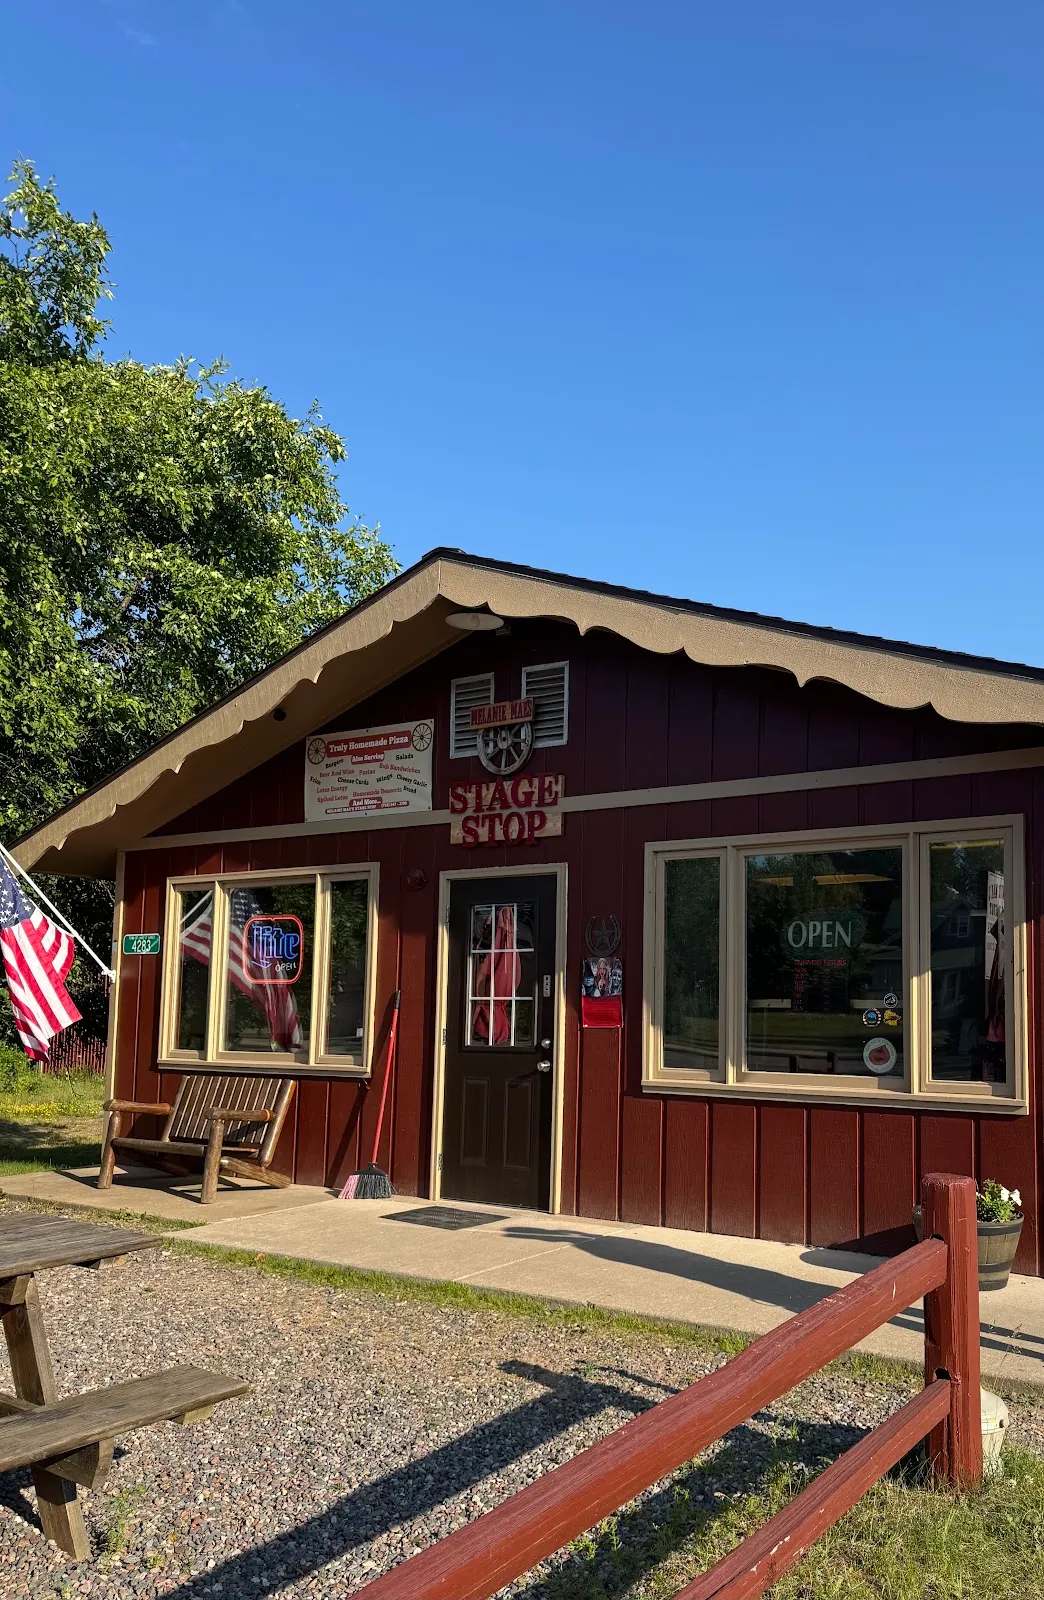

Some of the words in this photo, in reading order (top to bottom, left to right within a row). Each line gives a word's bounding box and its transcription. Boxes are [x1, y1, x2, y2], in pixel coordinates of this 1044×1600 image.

[329, 742, 348, 753] Truly
[348, 738, 388, 750] Homemade
[388, 735, 409, 745] Pizza
[364, 752, 385, 761] Serving
[395, 752, 414, 760] Salads
[325, 758, 344, 769] Burgers
[390, 764, 421, 774] Sandwiches
[337, 776, 355, 784] Cheese
[355, 777, 369, 786] Curds
[376, 773, 393, 783] Wings
[396, 773, 412, 784] Cheesy
[412, 778, 428, 788] Garlic
[403, 785, 417, 794] Bread
[449, 773, 560, 815] STAGE
[352, 800, 364, 808] And
[460, 810, 548, 848] STOP
[787, 920, 852, 948] OPEN
[131, 939, 151, 953] 4283
